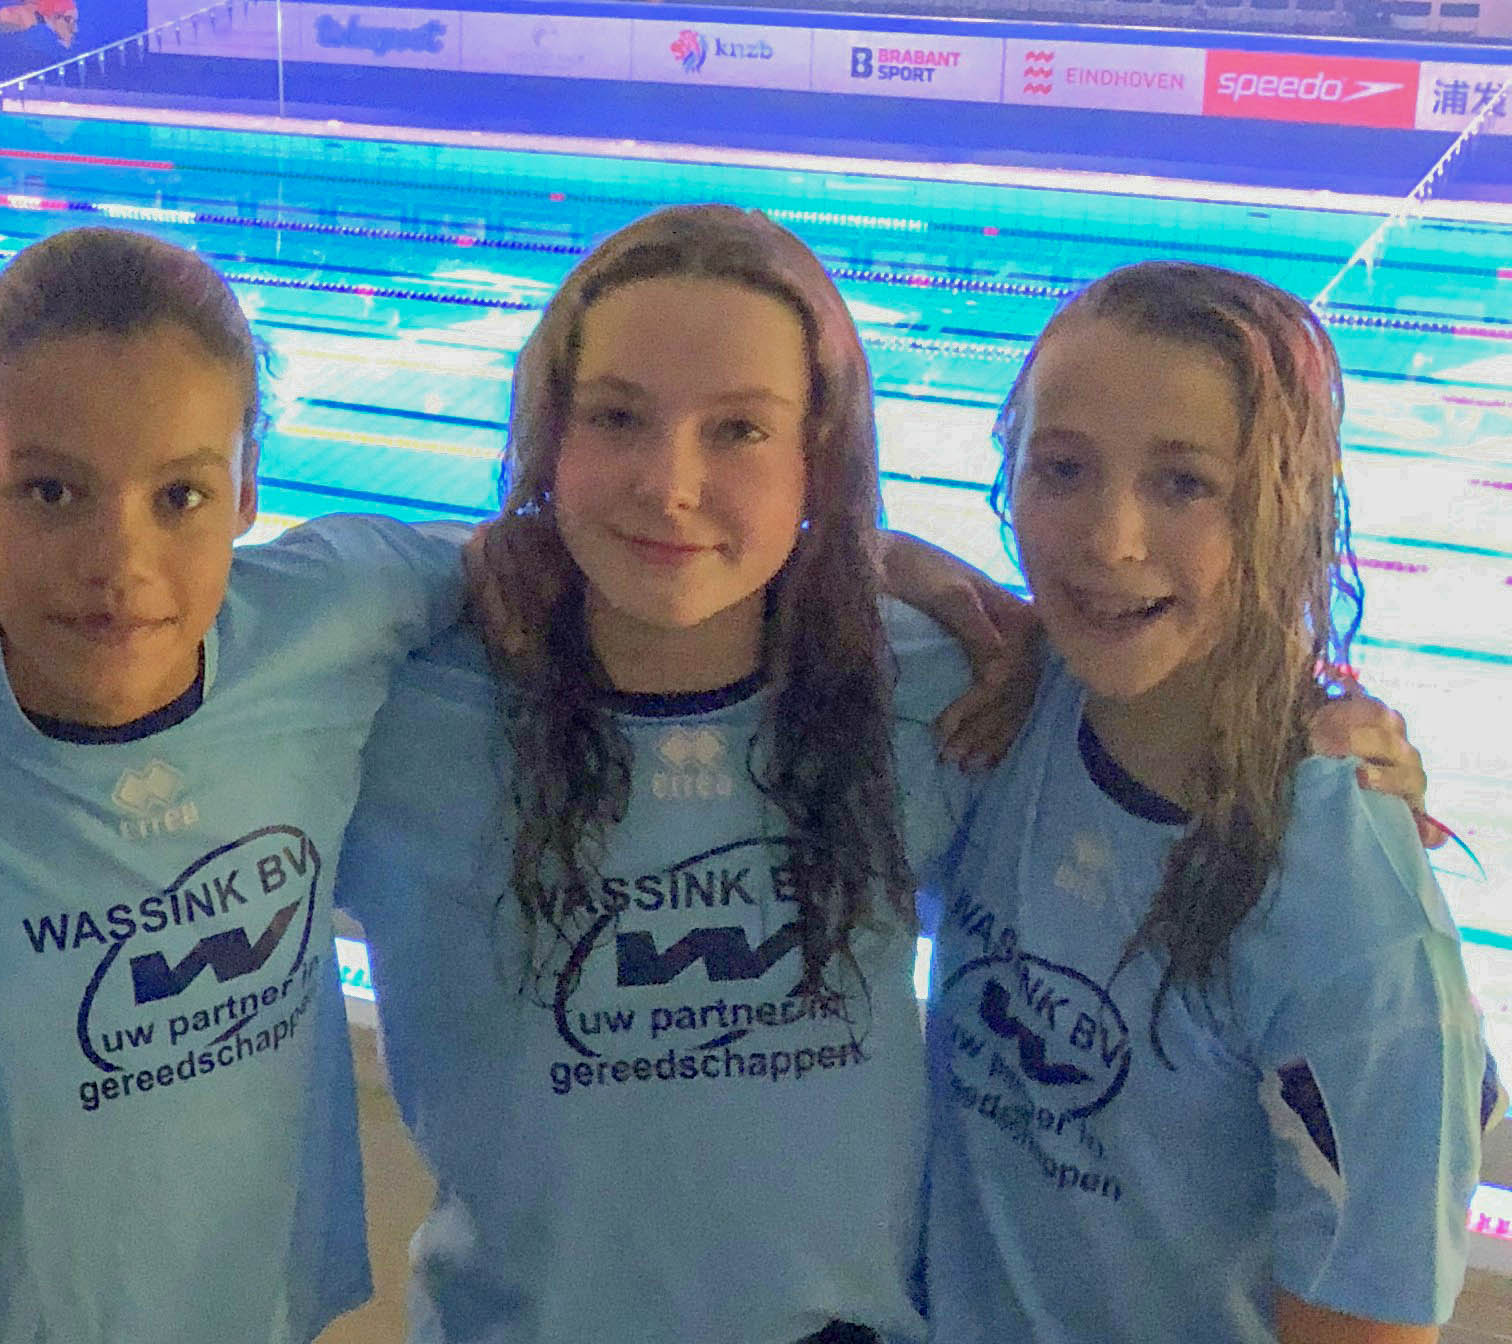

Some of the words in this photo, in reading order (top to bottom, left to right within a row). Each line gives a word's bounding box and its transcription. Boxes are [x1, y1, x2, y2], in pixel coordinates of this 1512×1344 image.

[715, 38, 774, 60] knzb
[877, 48, 961, 67] BRABANT
[877, 65, 936, 83] SPORT
[1064, 67, 1185, 90] EINDHOVEN
[1217, 71, 1344, 103] speedo
[22, 869, 248, 954] WASSINK
[256, 837, 311, 896] BV
[550, 866, 760, 917] SSINK
[101, 1022, 155, 1053] uw
[169, 977, 293, 1046] partner
[578, 1007, 635, 1035] uw
[651, 998, 795, 1039] partner
[1070, 1012, 1129, 1069] BV
[550, 1042, 863, 1094] gereedschappen
